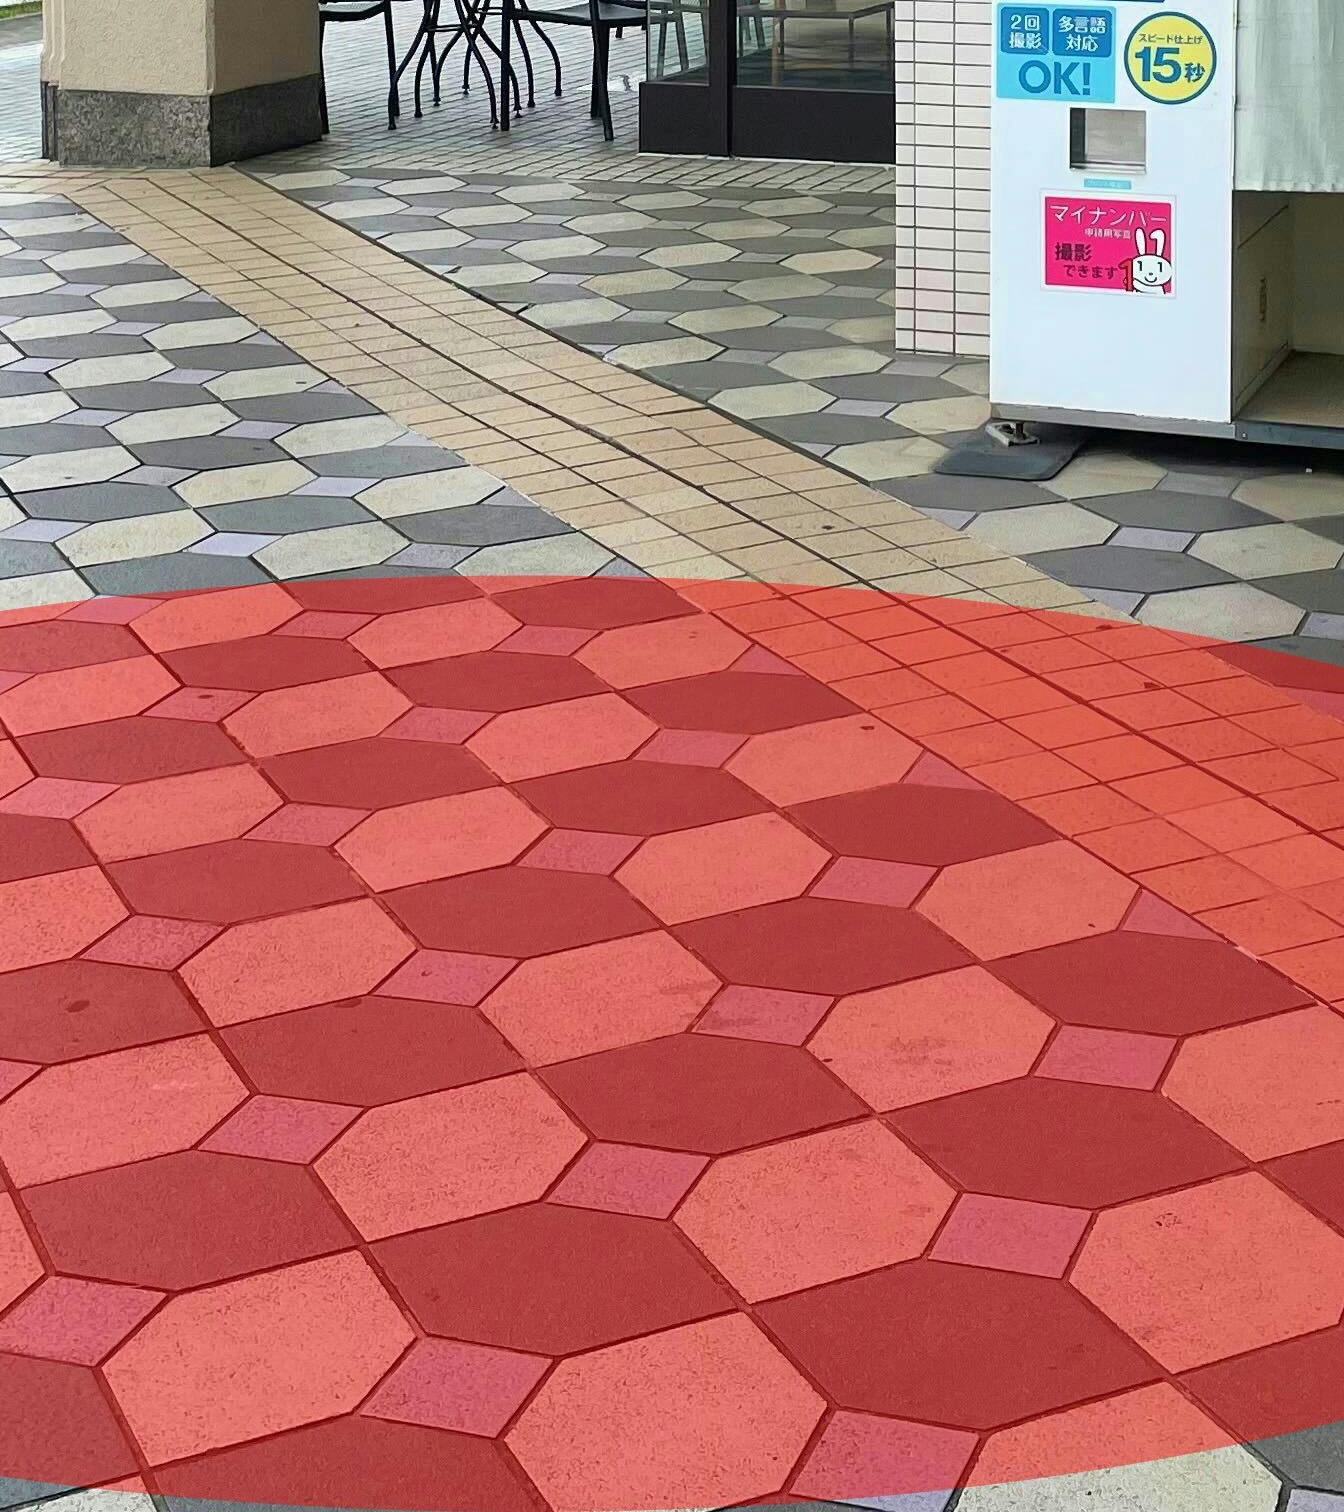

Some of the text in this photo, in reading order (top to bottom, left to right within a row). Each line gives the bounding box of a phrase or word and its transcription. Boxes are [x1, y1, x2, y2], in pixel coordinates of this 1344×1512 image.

[1010, 15, 1040, 30] 2回
[1058, 16, 1106, 34] 多言語
[1008, 33, 1042, 49] 撮影
[1065, 35, 1099, 52] 対応
[1138, 33, 1203, 45] スピード仕上げ
[1135, 46, 1206, 83] 15秒
[1018, 60, 1091, 96] OK!
[1050, 205, 1167, 226] マイナンバー
[1055, 242, 1092, 262] 撮影
[1064, 265, 1118, 279] できます
